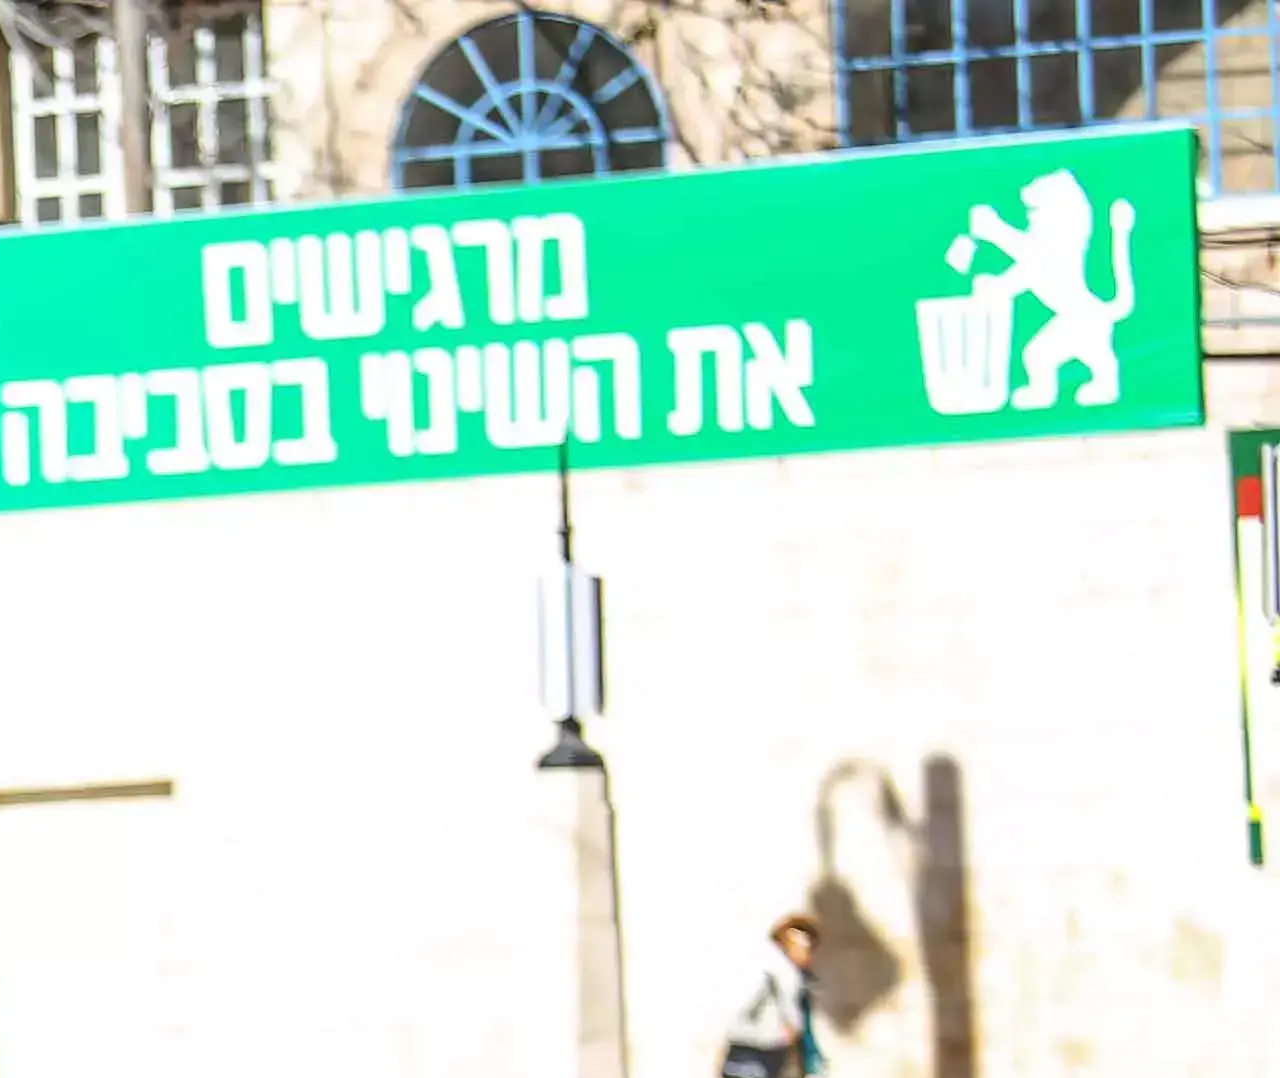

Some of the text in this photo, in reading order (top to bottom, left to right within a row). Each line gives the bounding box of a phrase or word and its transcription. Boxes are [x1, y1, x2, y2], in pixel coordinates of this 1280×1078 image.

[202, 213, 589, 349] מרגישים
[359, 331, 642, 457] השינוי
[666, 319, 816, 436] את
